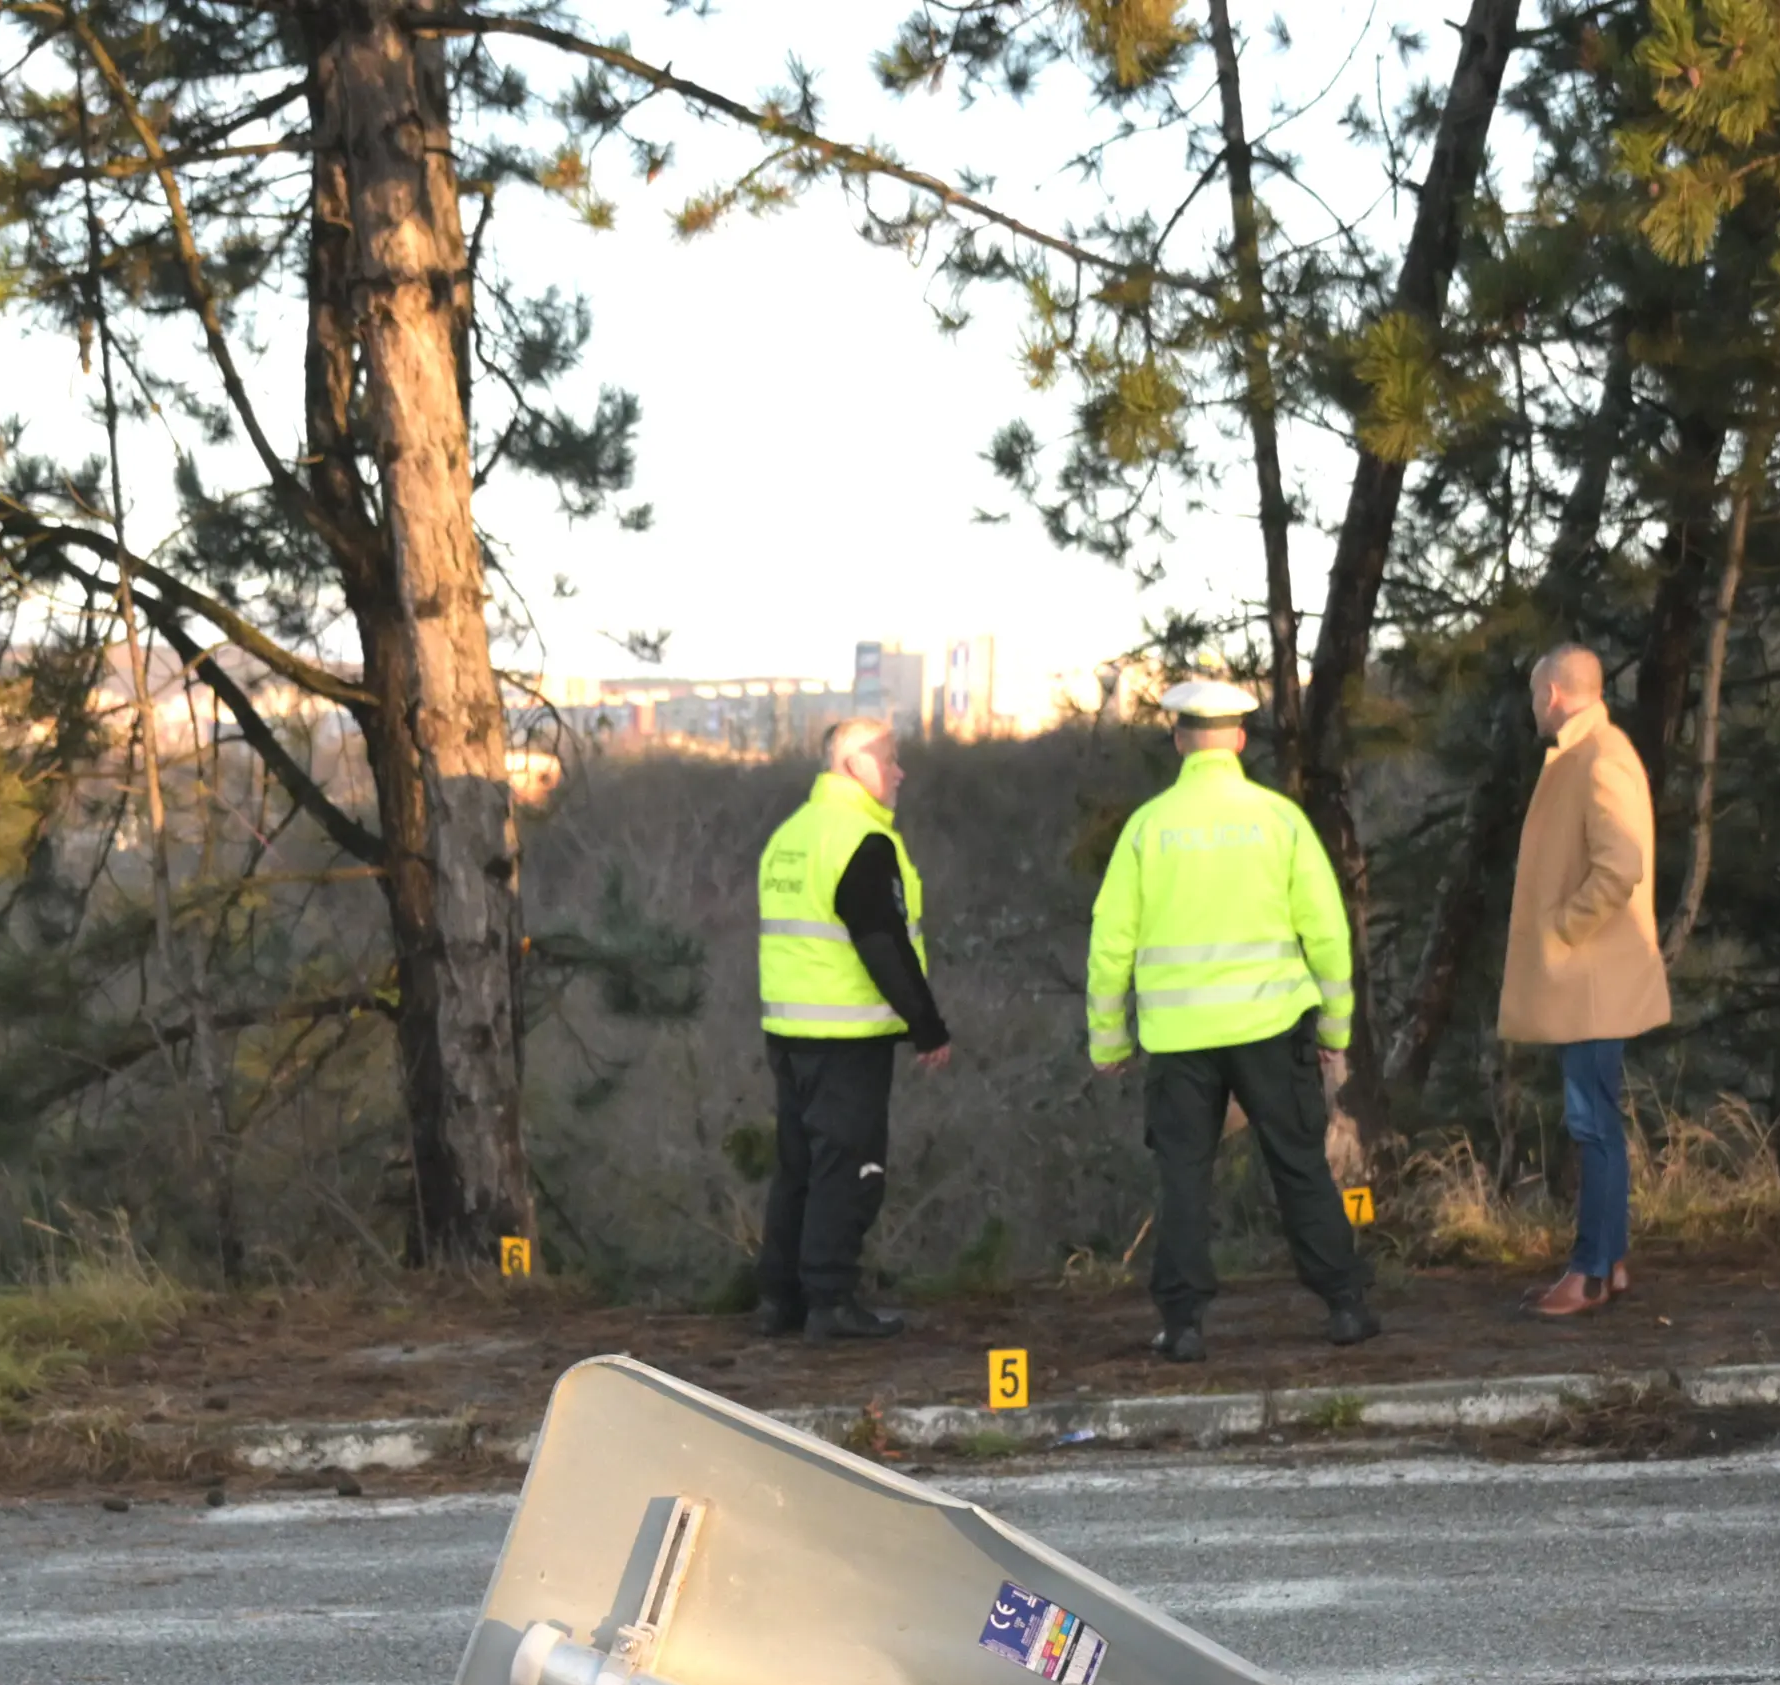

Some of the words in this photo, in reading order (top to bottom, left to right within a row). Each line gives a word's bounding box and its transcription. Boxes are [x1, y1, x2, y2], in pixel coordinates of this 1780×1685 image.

[1348, 1194, 1364, 1222] 7
[1000, 1358, 1020, 1399] 5
[990, 1599, 1016, 1630] CE
